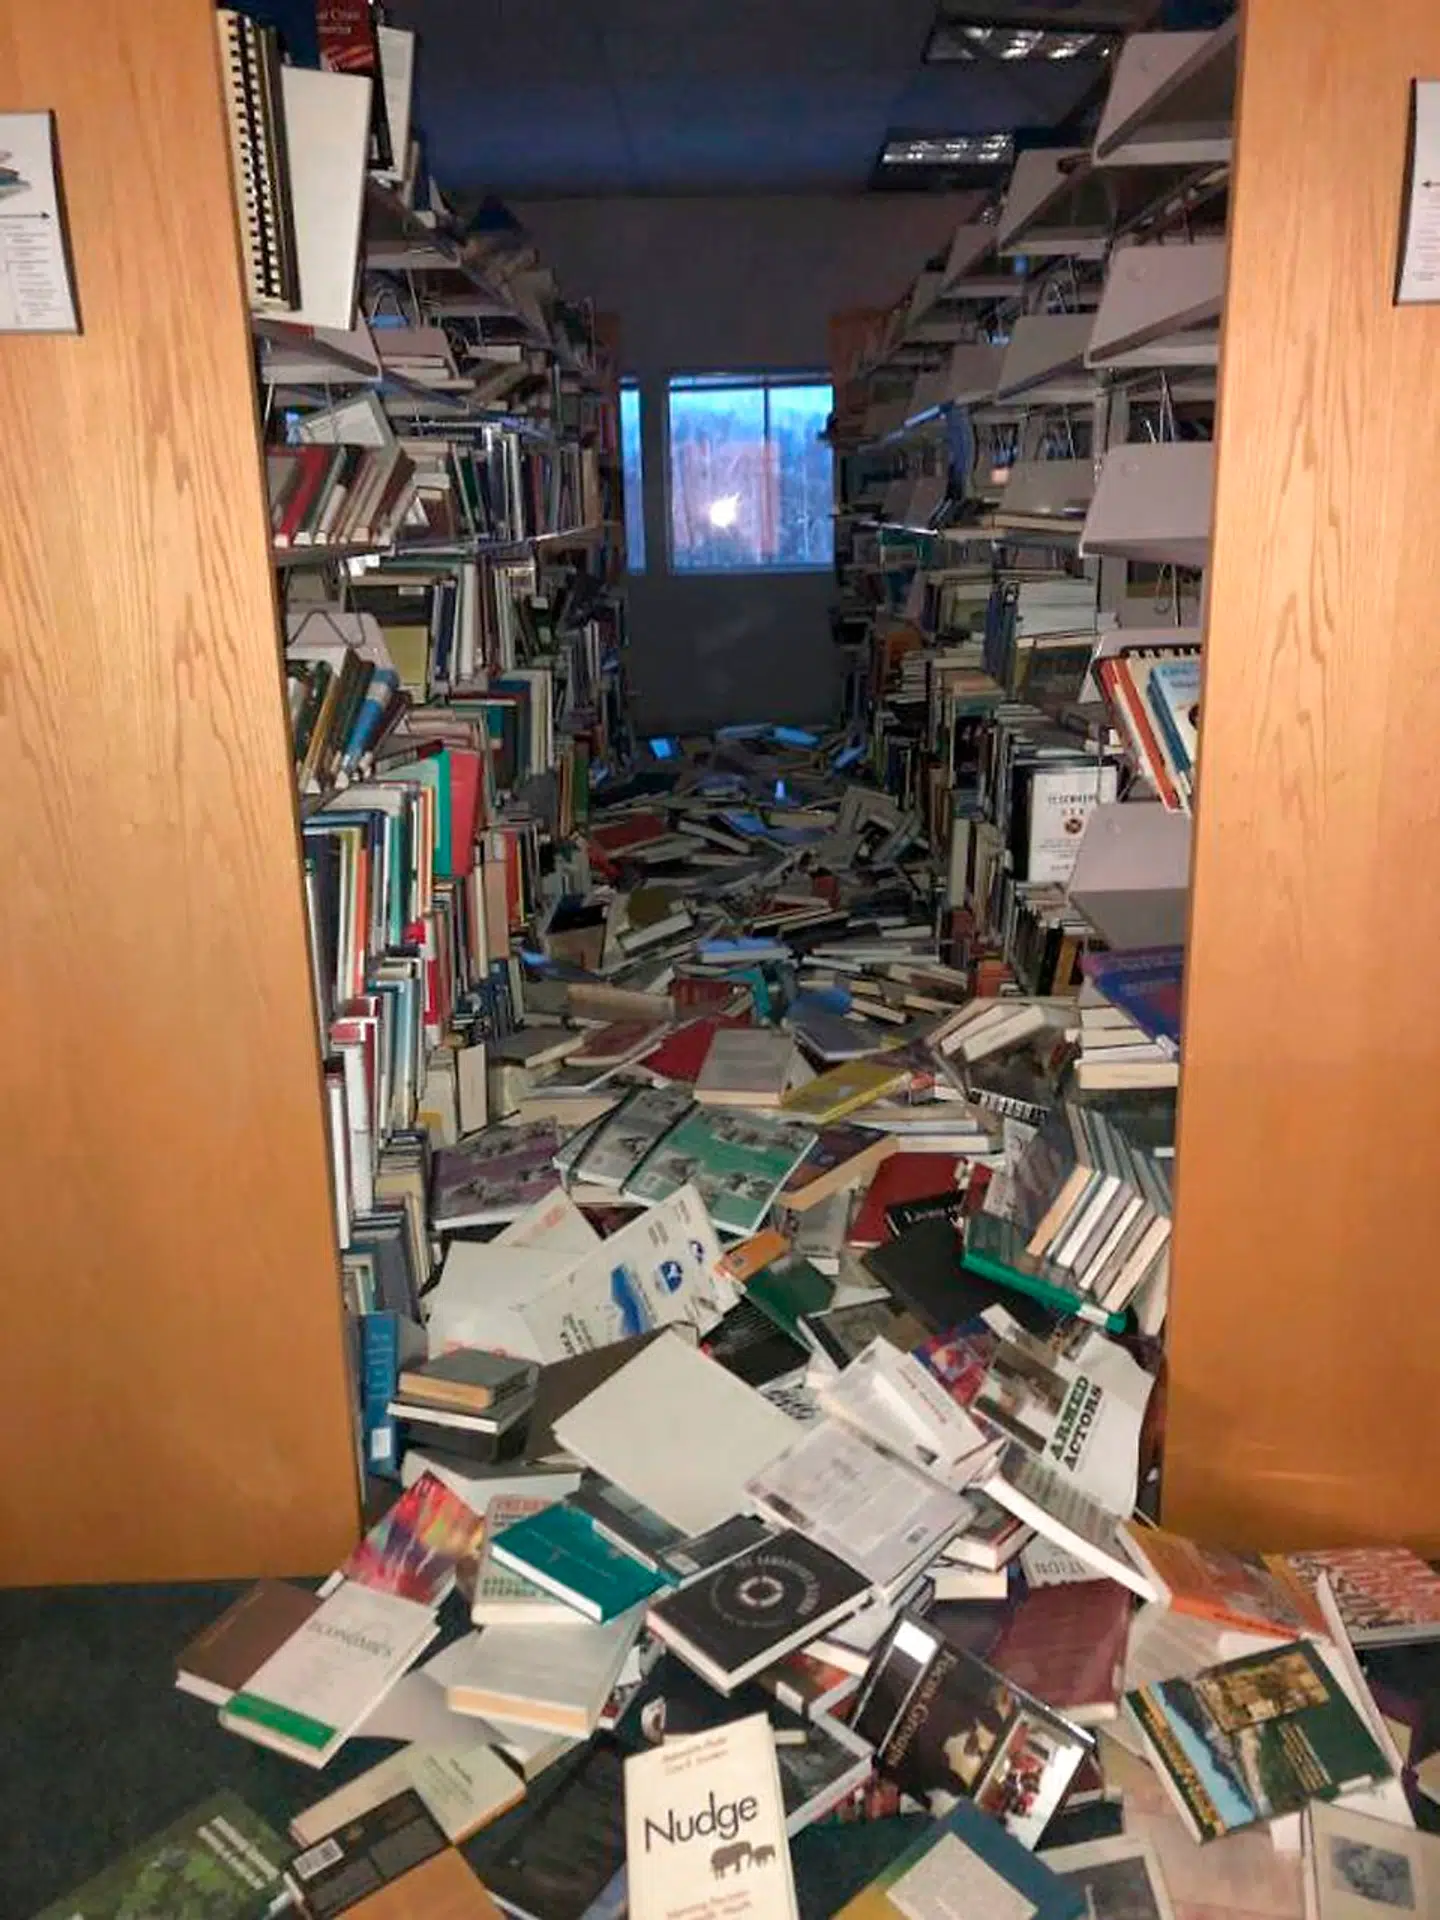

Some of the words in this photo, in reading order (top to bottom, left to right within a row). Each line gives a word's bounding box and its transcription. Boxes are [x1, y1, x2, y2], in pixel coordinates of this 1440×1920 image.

[1049, 1375, 1089, 1461] ARMED
[1063, 1384, 1103, 1472] ACTORS
[919, 1649, 960, 1699] Focus
[886, 1701, 929, 1768] Groups
[644, 1790, 758, 1853] Nudge
